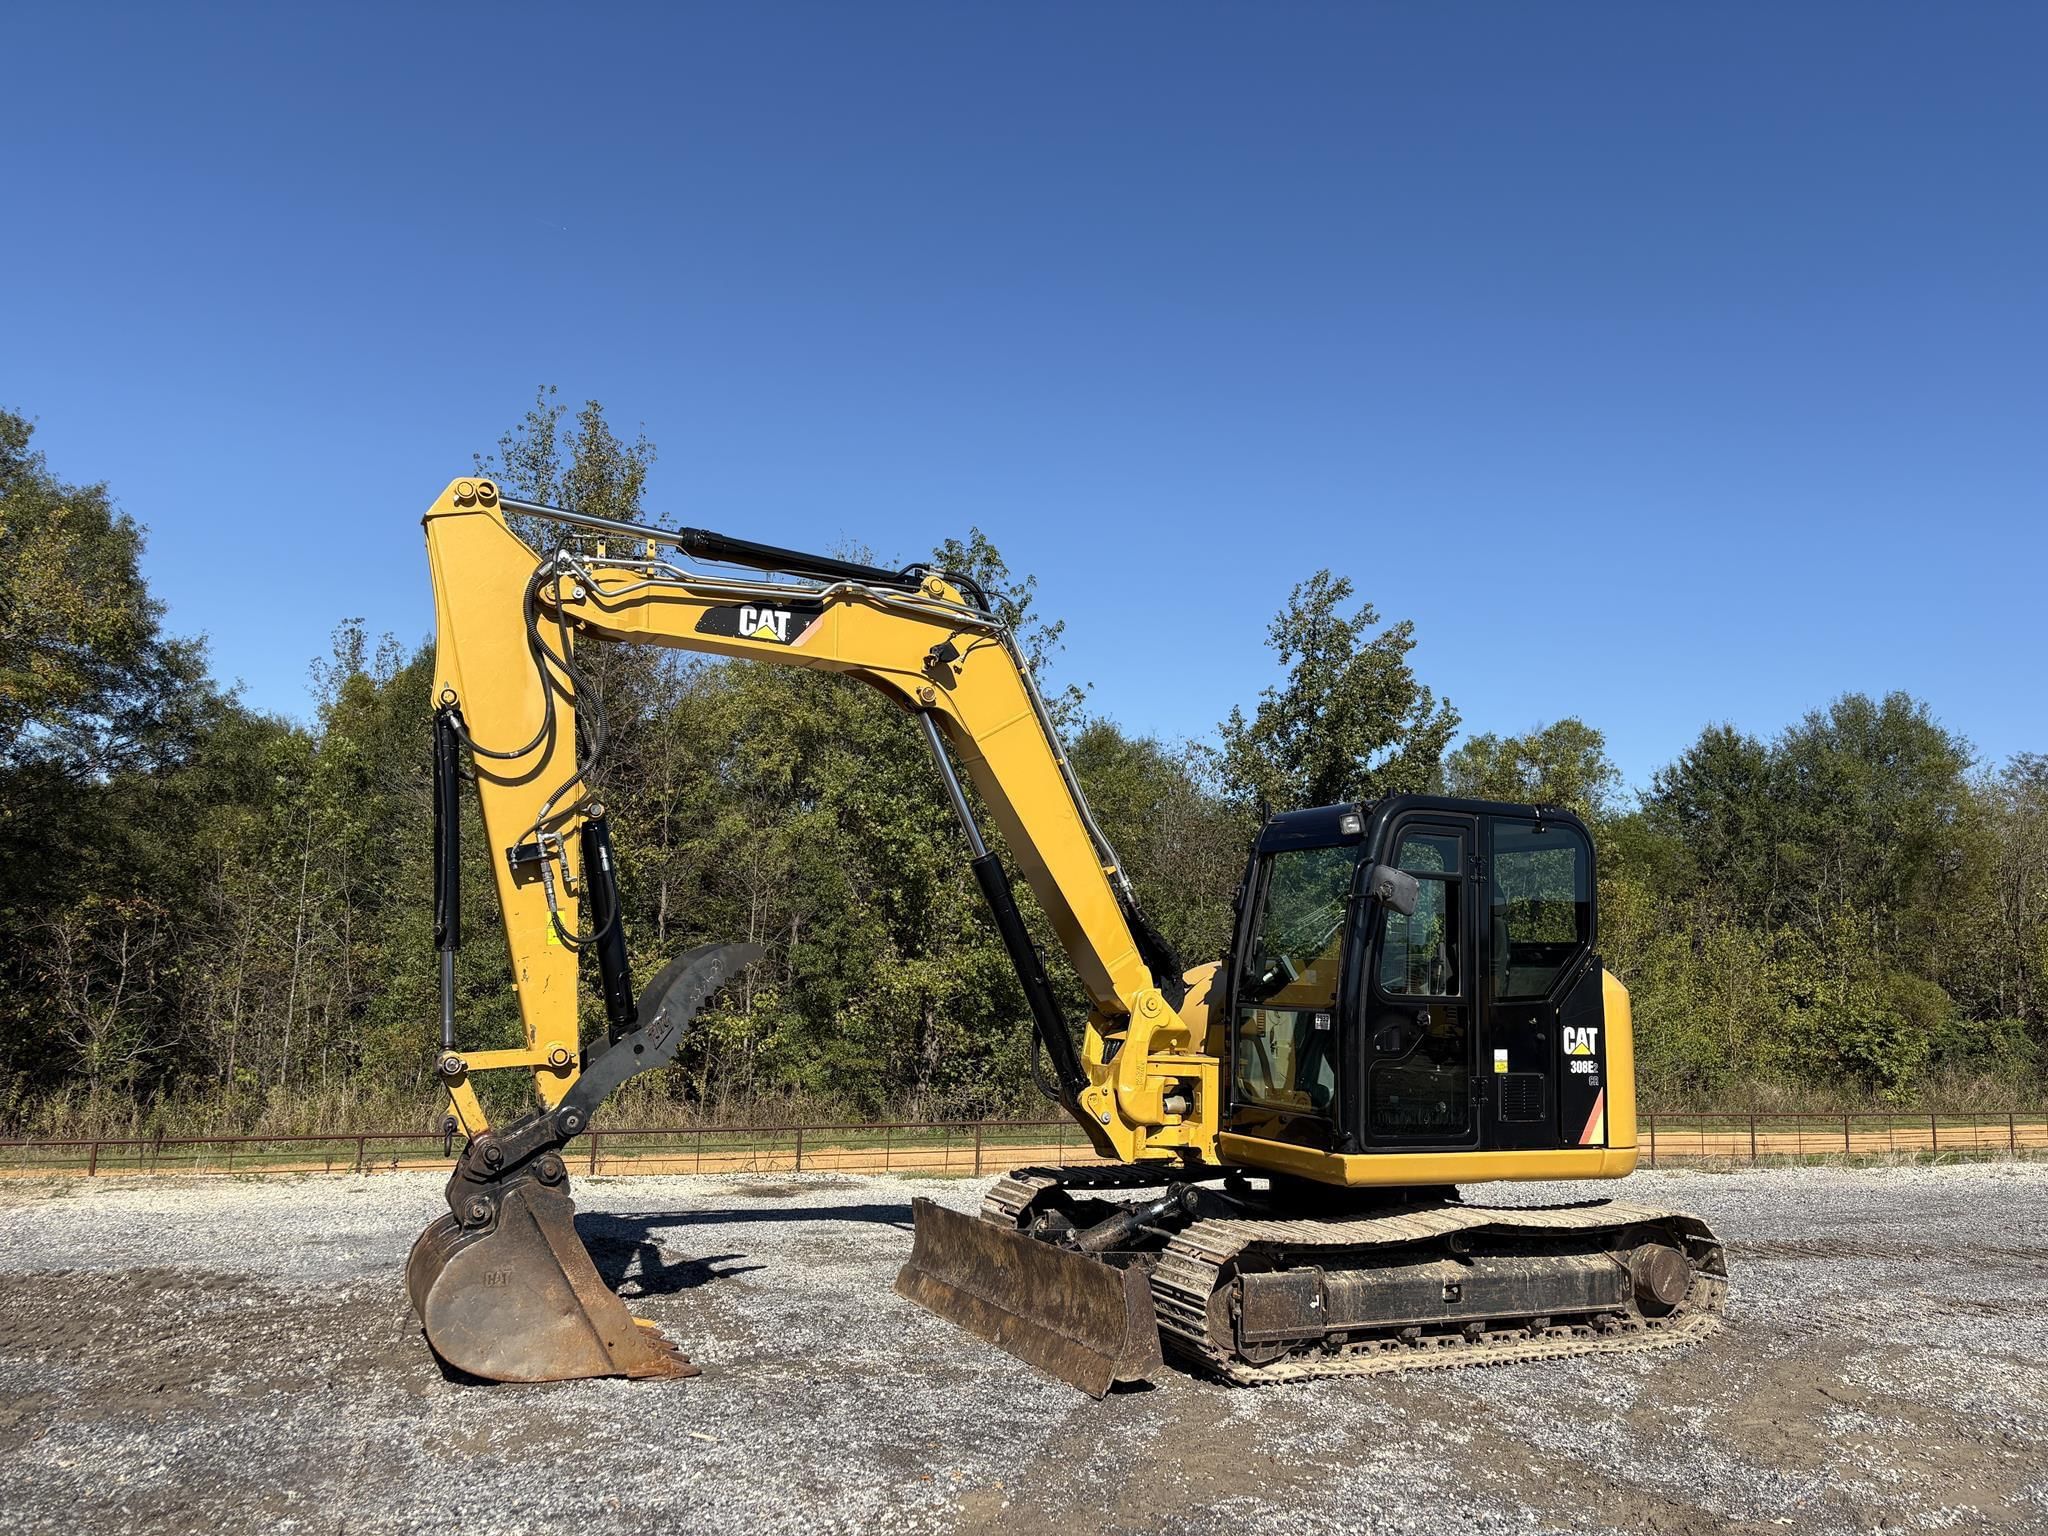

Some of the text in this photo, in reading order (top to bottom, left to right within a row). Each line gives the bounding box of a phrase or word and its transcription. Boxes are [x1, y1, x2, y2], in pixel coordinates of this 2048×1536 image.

[739, 605, 792, 642] CAT
[1563, 1026, 1598, 1055] CAT
[1570, 1060, 1599, 1074] 308E2
[1588, 1075, 1600, 1086] CR
[484, 1270, 512, 1288] CAT
